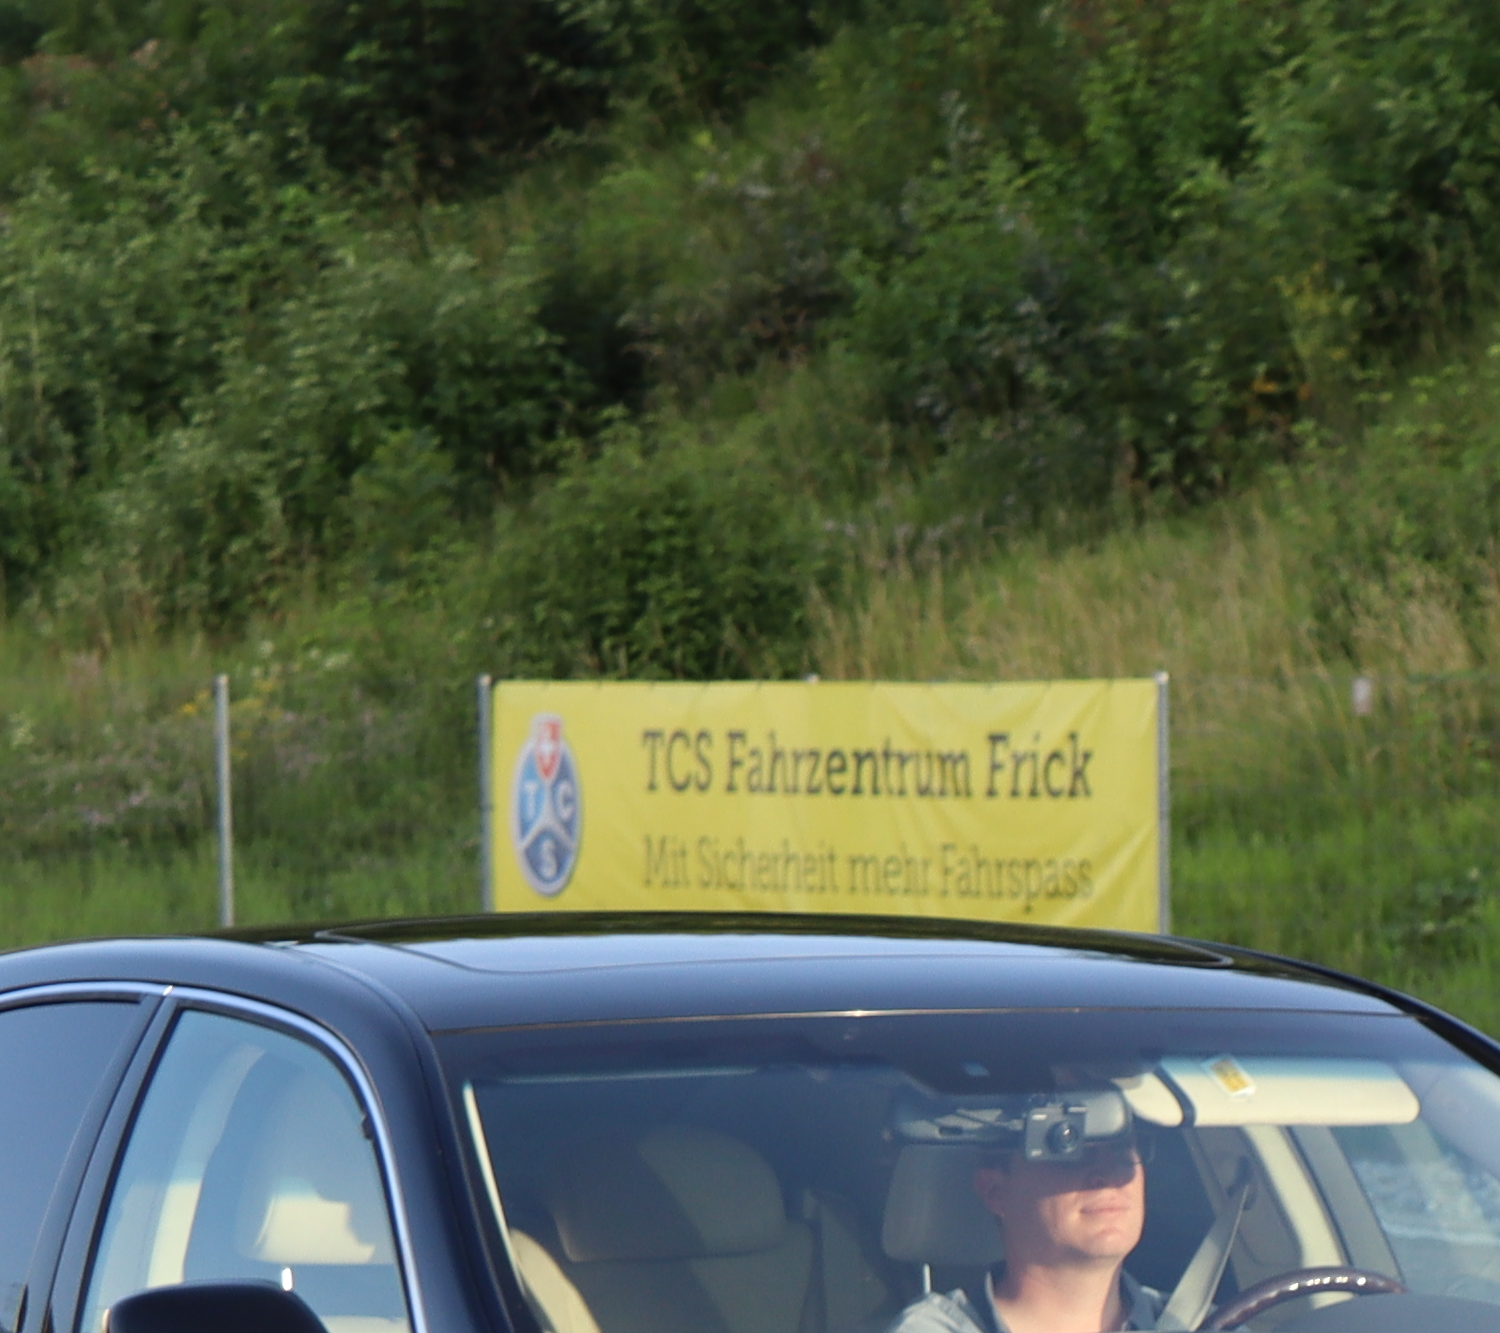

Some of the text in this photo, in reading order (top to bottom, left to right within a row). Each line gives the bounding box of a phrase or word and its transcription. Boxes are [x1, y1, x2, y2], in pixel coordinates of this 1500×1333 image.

[642, 728, 1094, 798] TCS Fahrzentrum Frick
[643, 834, 1095, 915] Mit Sicherheit mehr Fahrspass
